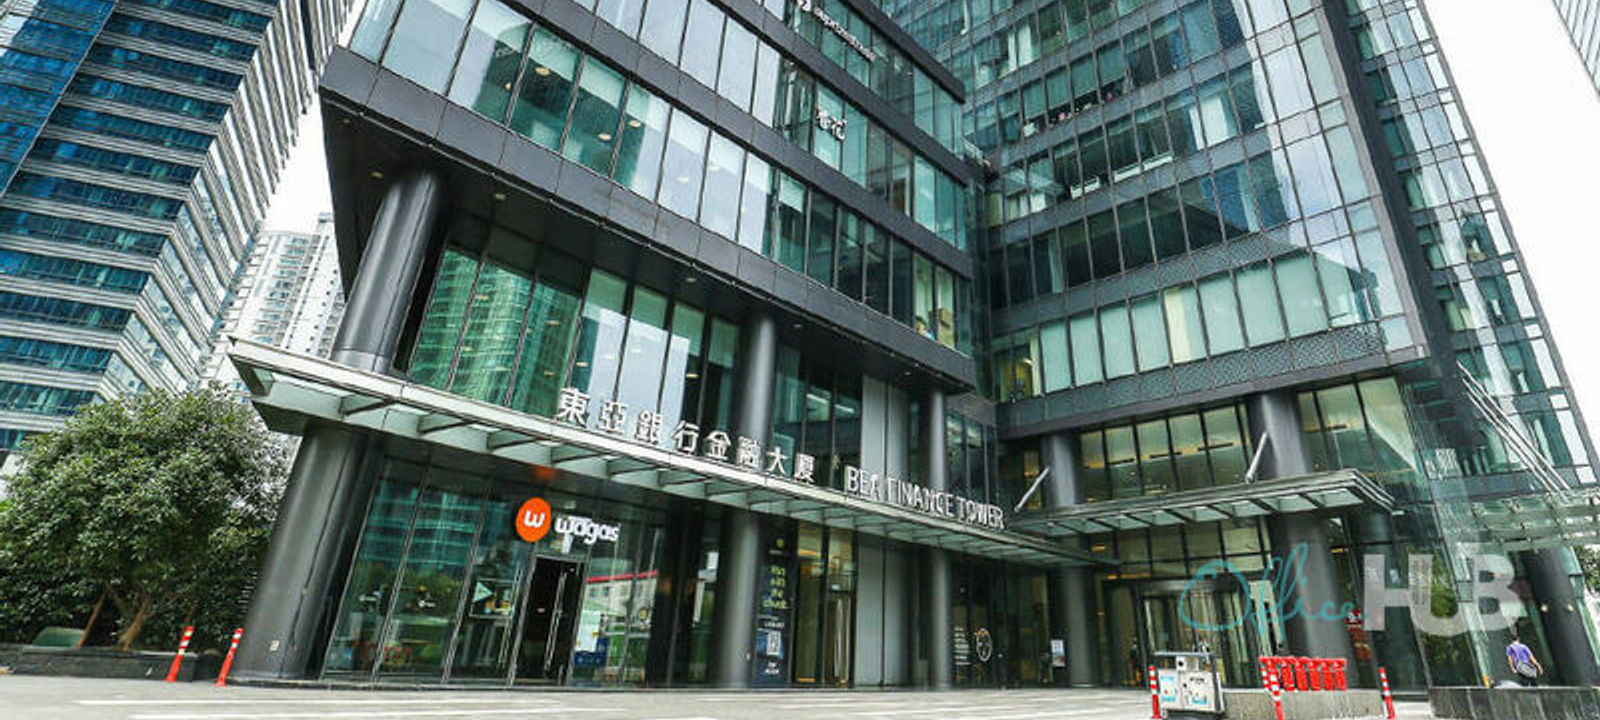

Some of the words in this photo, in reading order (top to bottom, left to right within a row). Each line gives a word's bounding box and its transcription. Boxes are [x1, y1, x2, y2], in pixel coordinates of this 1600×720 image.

[845, 465, 881, 501] BEA
[886, 476, 955, 517] FINANCE
[956, 496, 1005, 531] TOWER
[554, 516, 620, 545] wagas
